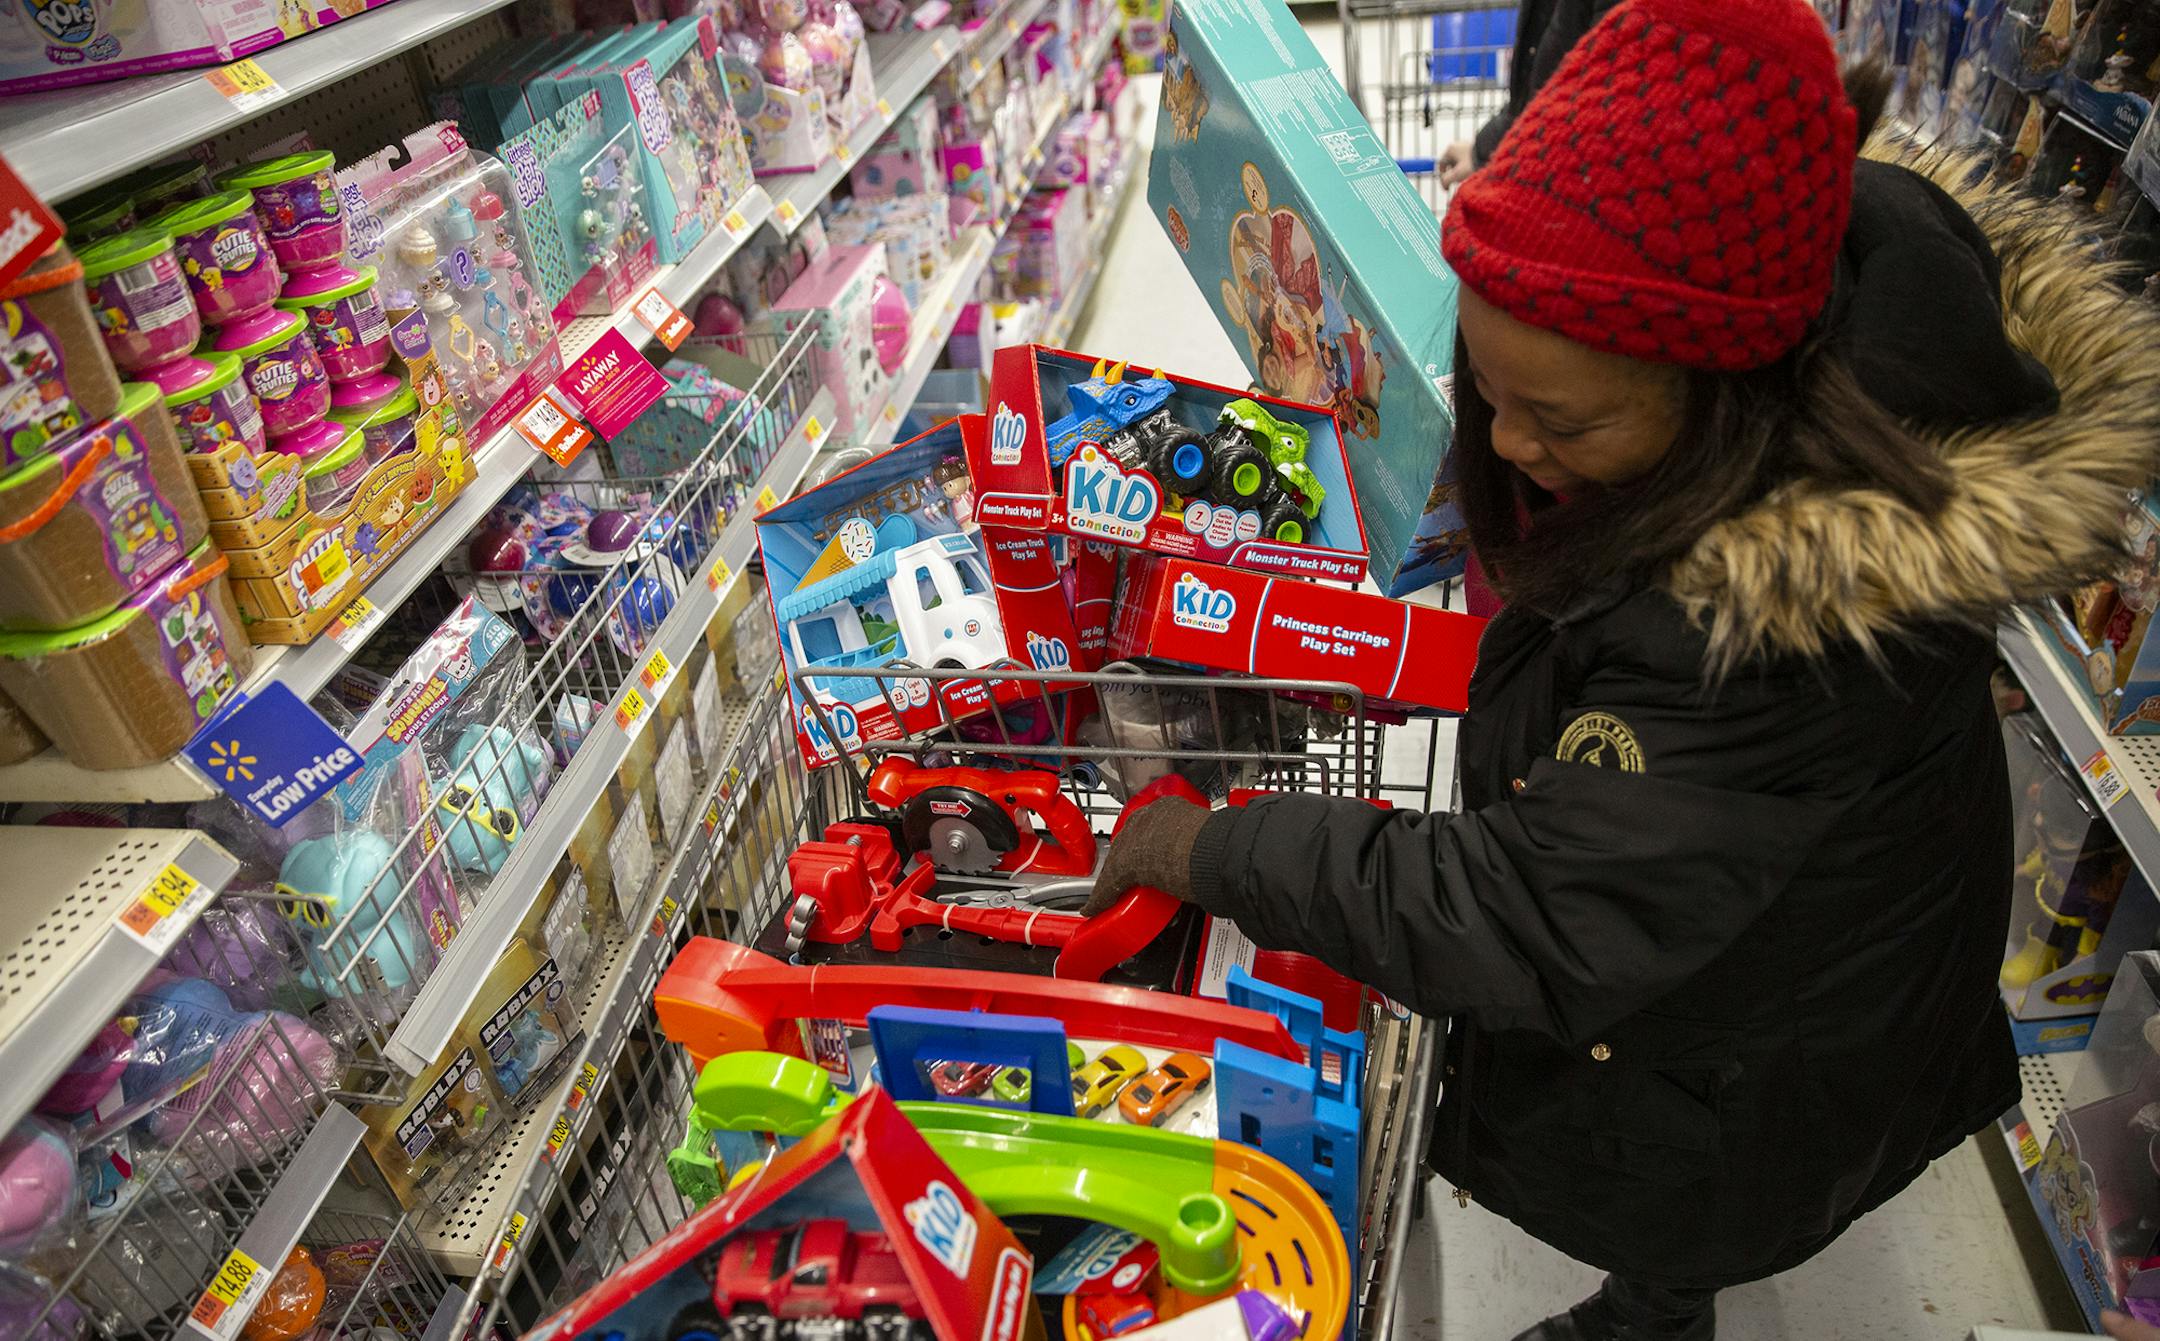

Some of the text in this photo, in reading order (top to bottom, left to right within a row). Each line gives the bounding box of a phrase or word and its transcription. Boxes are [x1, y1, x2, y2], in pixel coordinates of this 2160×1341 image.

[212, 230, 251, 255] CUTIE
[217, 242, 257, 266] FRUITIES
[252, 361, 293, 385] CUTIE
[256, 372, 298, 395] FRUITIES
[574, 350, 621, 395] LAYAWAY
[557, 426, 586, 453] Rollback
[993, 416, 1026, 449] KID
[992, 452, 1020, 462] Connection
[1073, 466, 1154, 522] KID
[983, 503, 1042, 519] Monster Truck Play Set
[1052, 513, 1064, 524] 3+
[1195, 511, 1204, 521] 7
[1071, 516, 1143, 539] Connection
[996, 538, 1045, 550] Ice Cream Truck
[1011, 550, 1037, 560] Play Set
[1245, 550, 1360, 575] Monster Truck Play Set
[1176, 586, 1233, 620] KID
[485, 624, 501, 640] SLO
[1176, 615, 1226, 630] Connection
[1272, 614, 1390, 648] Princess Carriage
[491, 628, 509, 649] RIZE
[1300, 635, 1356, 657] Play Set
[1029, 640, 1068, 670] KID
[408, 682, 425, 700] SLO
[907, 680, 920, 689] Light
[950, 692, 961, 700] Ice
[961, 684, 983, 697] Cream
[911, 693, 926, 701] Sound
[966, 694, 981, 705] Play
[386, 677, 446, 742] SQUISHIES
[404, 694, 449, 742] MOUS ET DOUX
[808, 756, 817, 765] 3+
[247, 775, 284, 803] Everyday
[256, 747, 356, 820] Low Price
[482, 962, 556, 1043] ROBLOX
[399, 1053, 473, 1142] ROBLOX
[921, 1187, 962, 1260] KID
